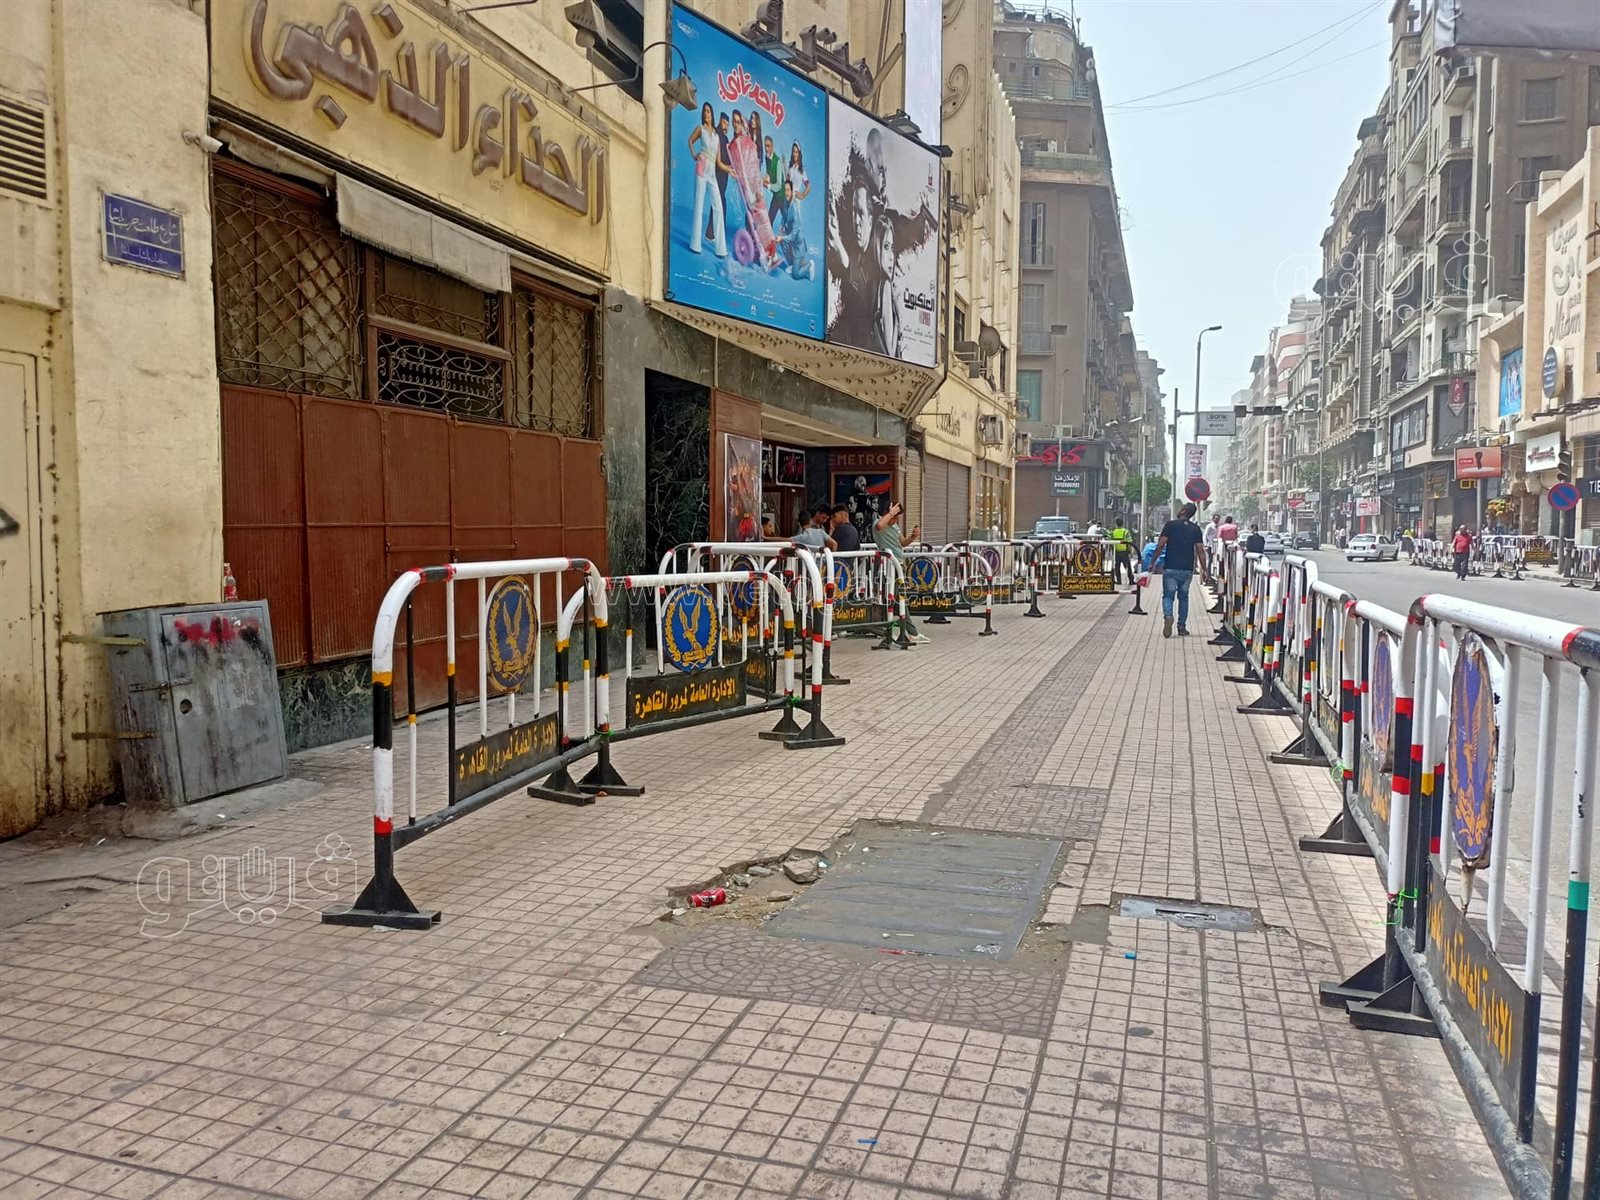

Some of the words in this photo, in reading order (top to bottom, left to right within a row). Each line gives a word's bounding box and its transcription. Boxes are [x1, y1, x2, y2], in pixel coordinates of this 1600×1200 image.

[134, 216, 160, 234] طلعت
[837, 454, 888, 465] METRO
[668, 685, 688, 712] لمرور
[689, 682, 711, 703] العامة
[634, 689, 668, 719] القاهرة
